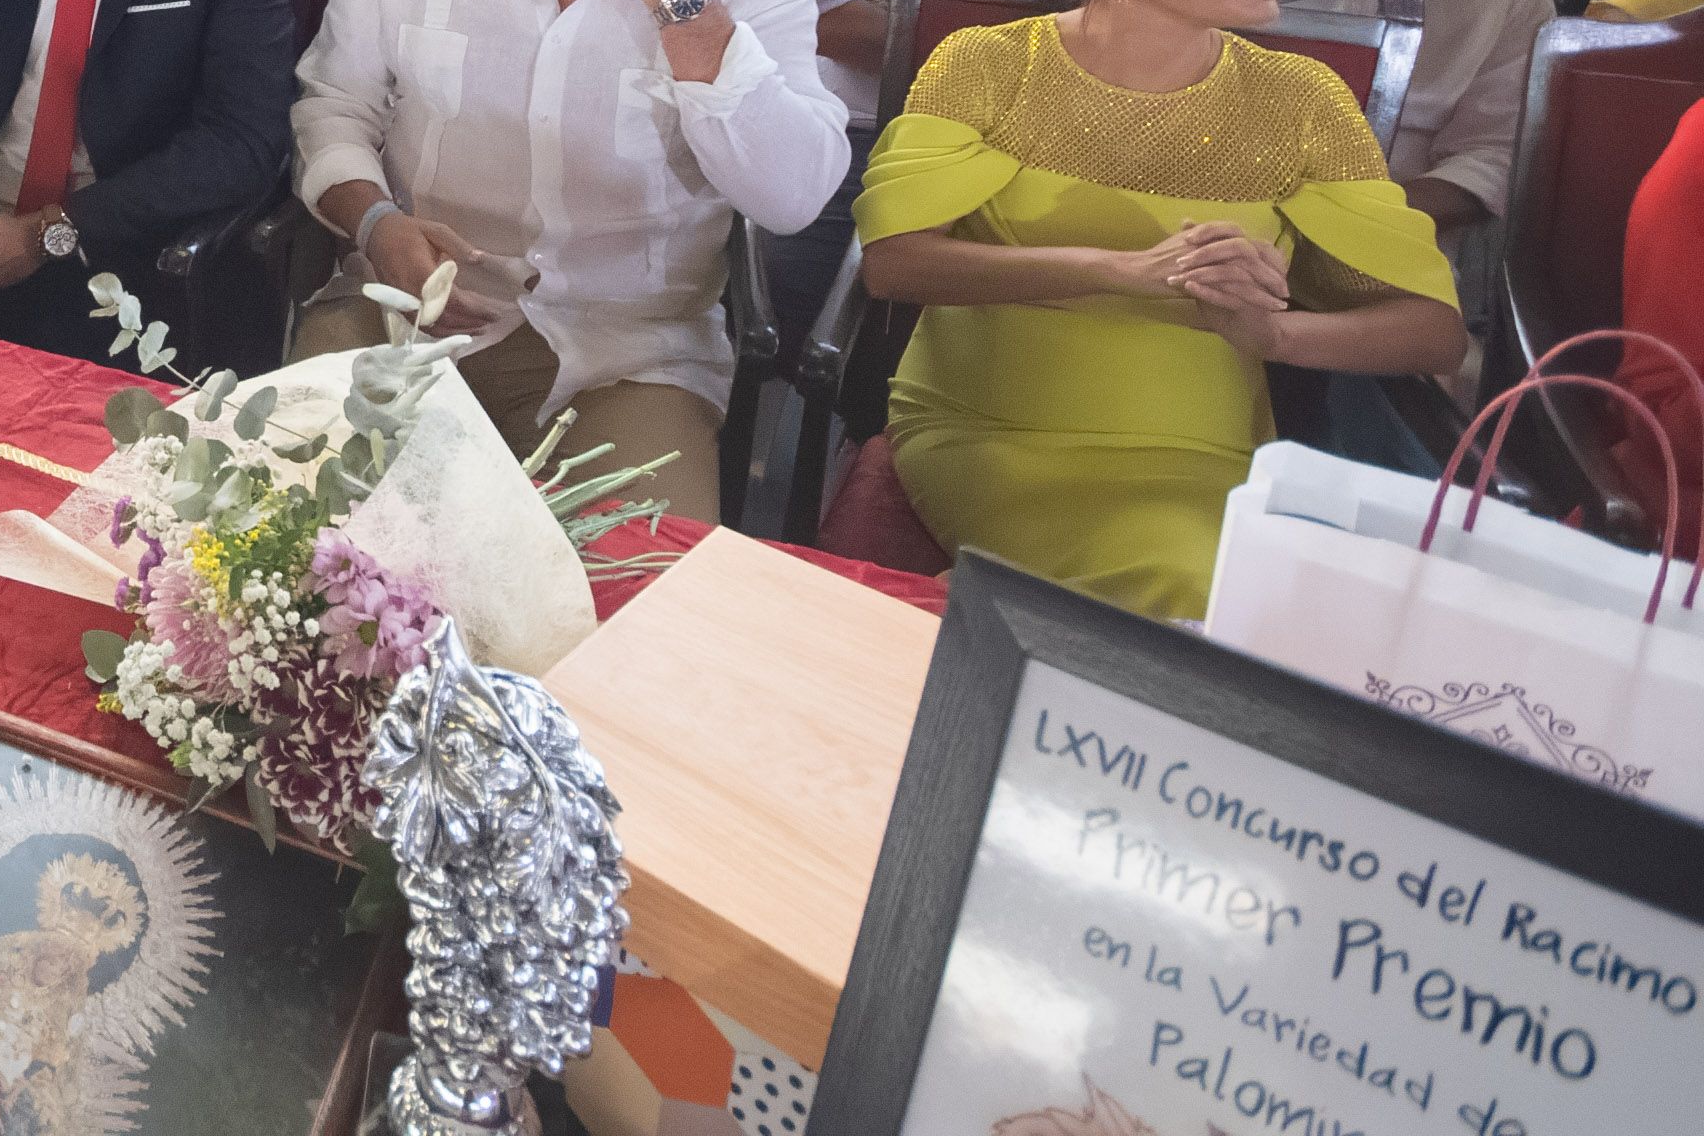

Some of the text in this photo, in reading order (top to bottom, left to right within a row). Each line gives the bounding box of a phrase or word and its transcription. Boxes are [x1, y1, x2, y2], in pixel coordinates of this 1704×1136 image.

[1034, 709, 1697, 1015] LXVII Concurso del Racimo
[1078, 807, 1597, 1081] Primer Premio
[1083, 926, 1132, 968] en
[1145, 944, 1184, 991] la
[1210, 975, 1435, 1112] Variedad
